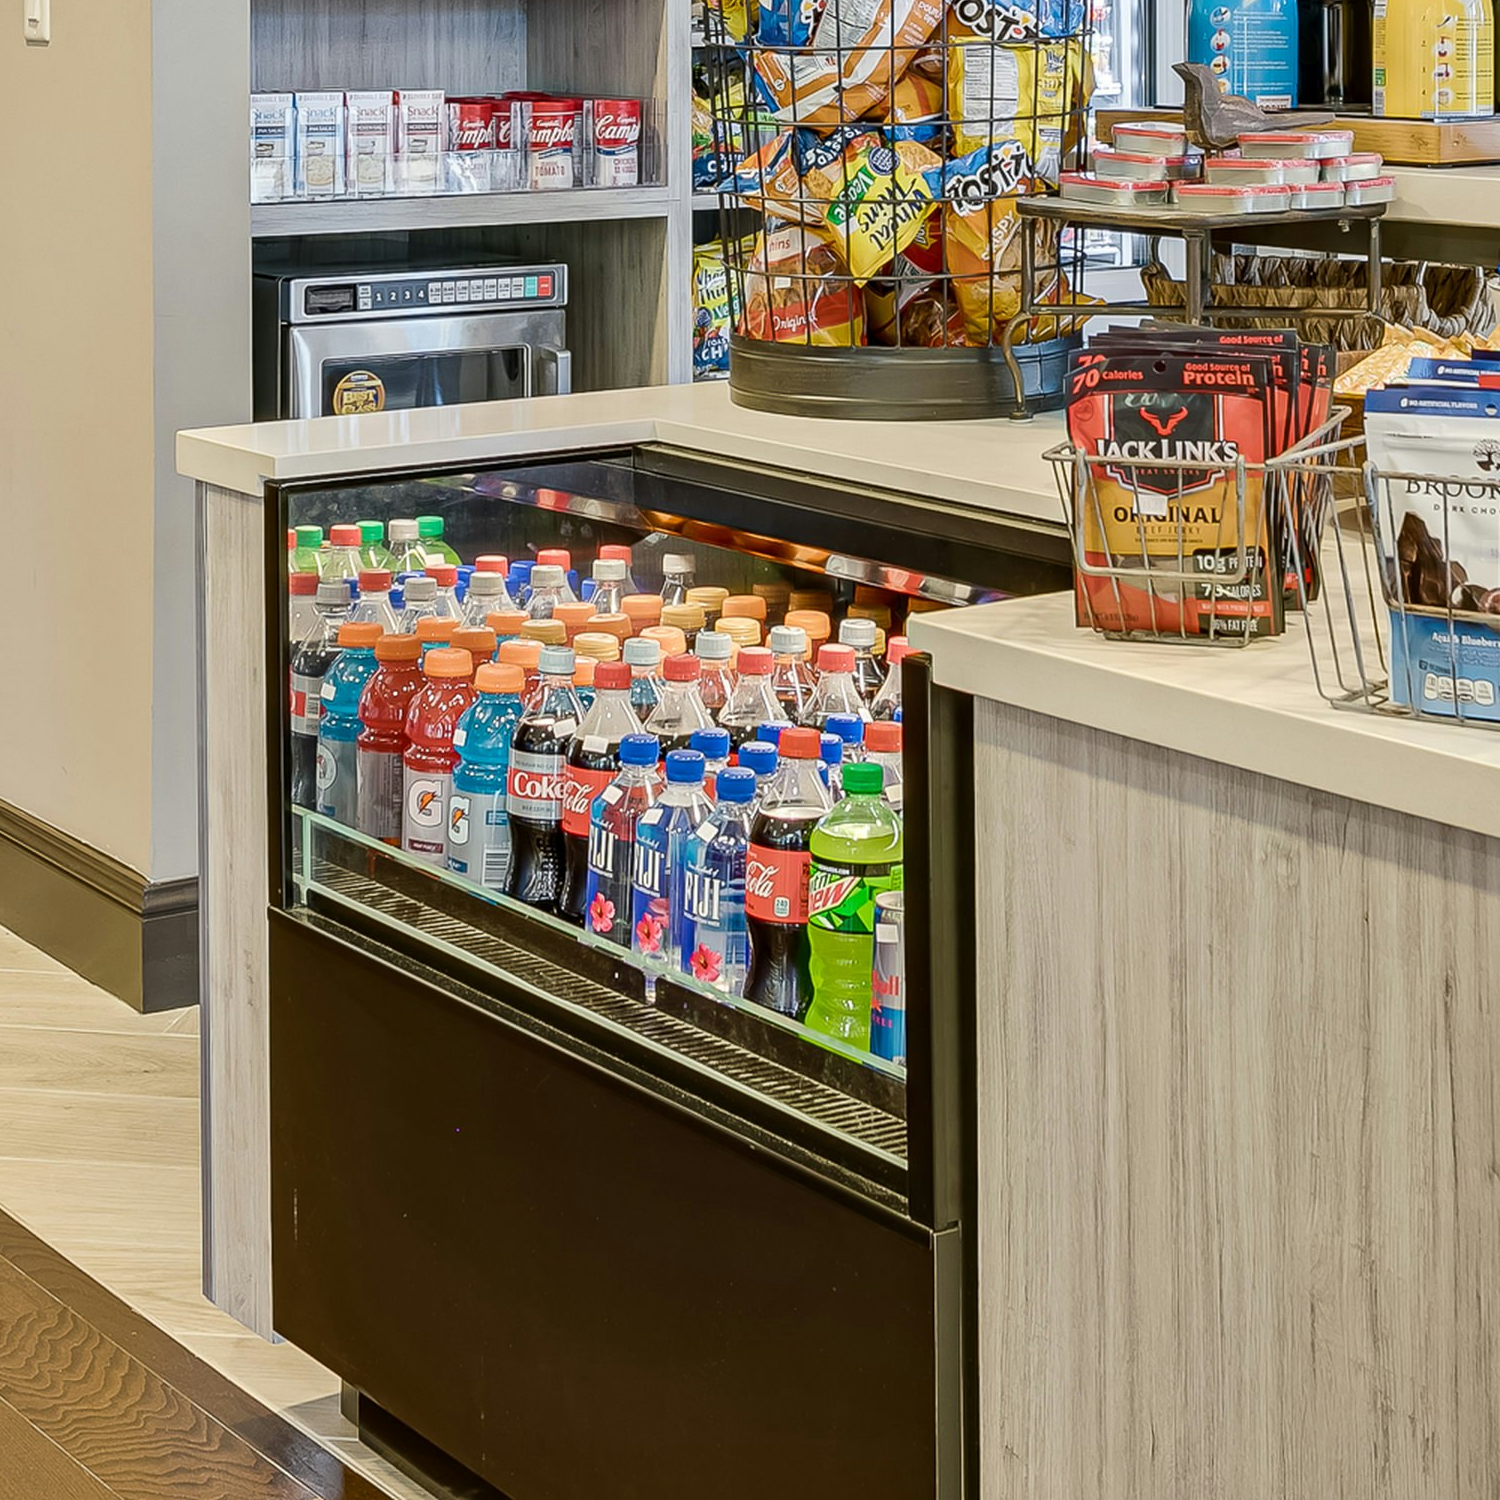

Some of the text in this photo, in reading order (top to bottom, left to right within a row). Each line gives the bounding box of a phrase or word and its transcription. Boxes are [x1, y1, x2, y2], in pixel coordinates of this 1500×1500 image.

[376, 293, 382, 301] 1
[390, 292, 397, 301] 2
[404, 291, 411, 300] 3
[417, 290, 424, 299] 4
[1219, 336, 1242, 345] Good
[1184, 362, 1251, 375] Good Source of
[1073, 368, 1144, 395] 70 calories
[1183, 371, 1255, 386] Protein
[1097, 439, 1238, 463] JACK LINK'S
[514, 771, 565, 799] Coke
[409, 780, 444, 827] G
[448, 795, 471, 845] G
[684, 871, 722, 920] FIJI
